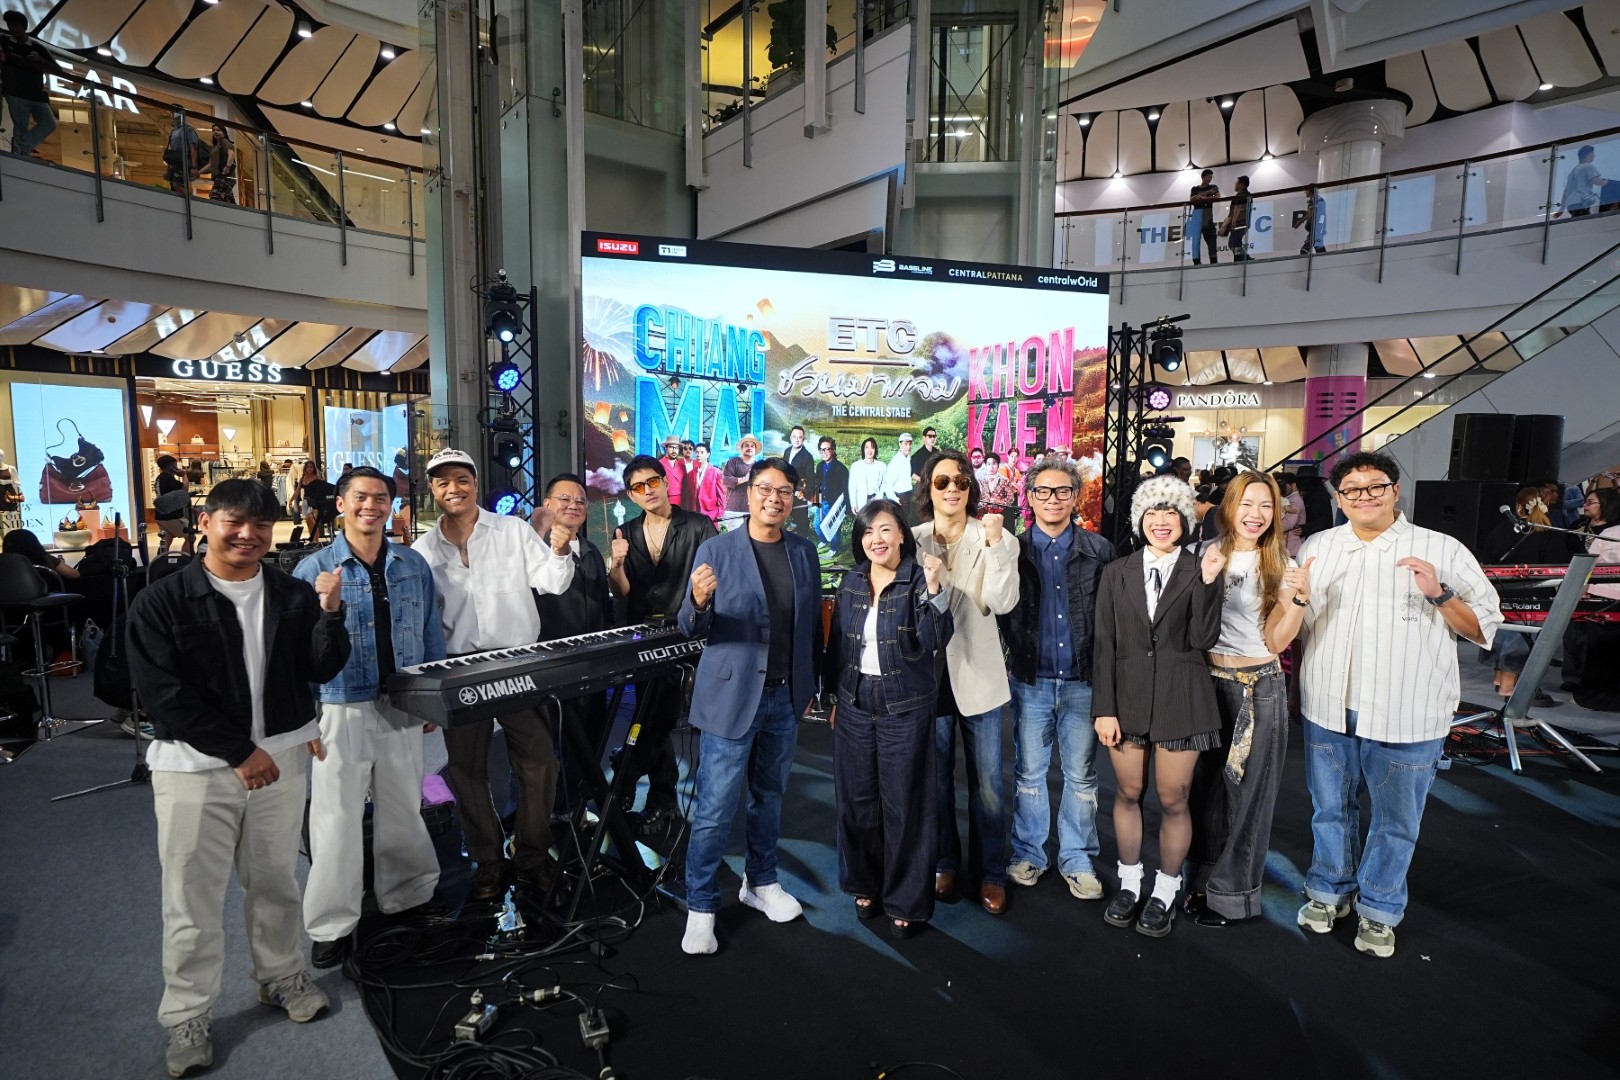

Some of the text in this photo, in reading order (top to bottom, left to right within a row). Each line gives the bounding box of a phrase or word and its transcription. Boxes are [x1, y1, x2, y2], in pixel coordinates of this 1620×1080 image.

[599, 241, 637, 252] ISUZU
[948, 268, 1023, 282] CENTRALPATTANA
[1037, 275, 1098, 288] centralwOrld
[633, 304, 766, 384] CHIANG
[828, 316, 918, 355] ETC
[172, 359, 282, 383] GUESS
[968, 326, 1075, 401] KHON
[634, 375, 766, 466] MAI
[831, 405, 911, 418] THE CENTRAL STAGE
[967, 396, 1073, 467] KAEN
[476, 674, 537, 701] YAMAHA
